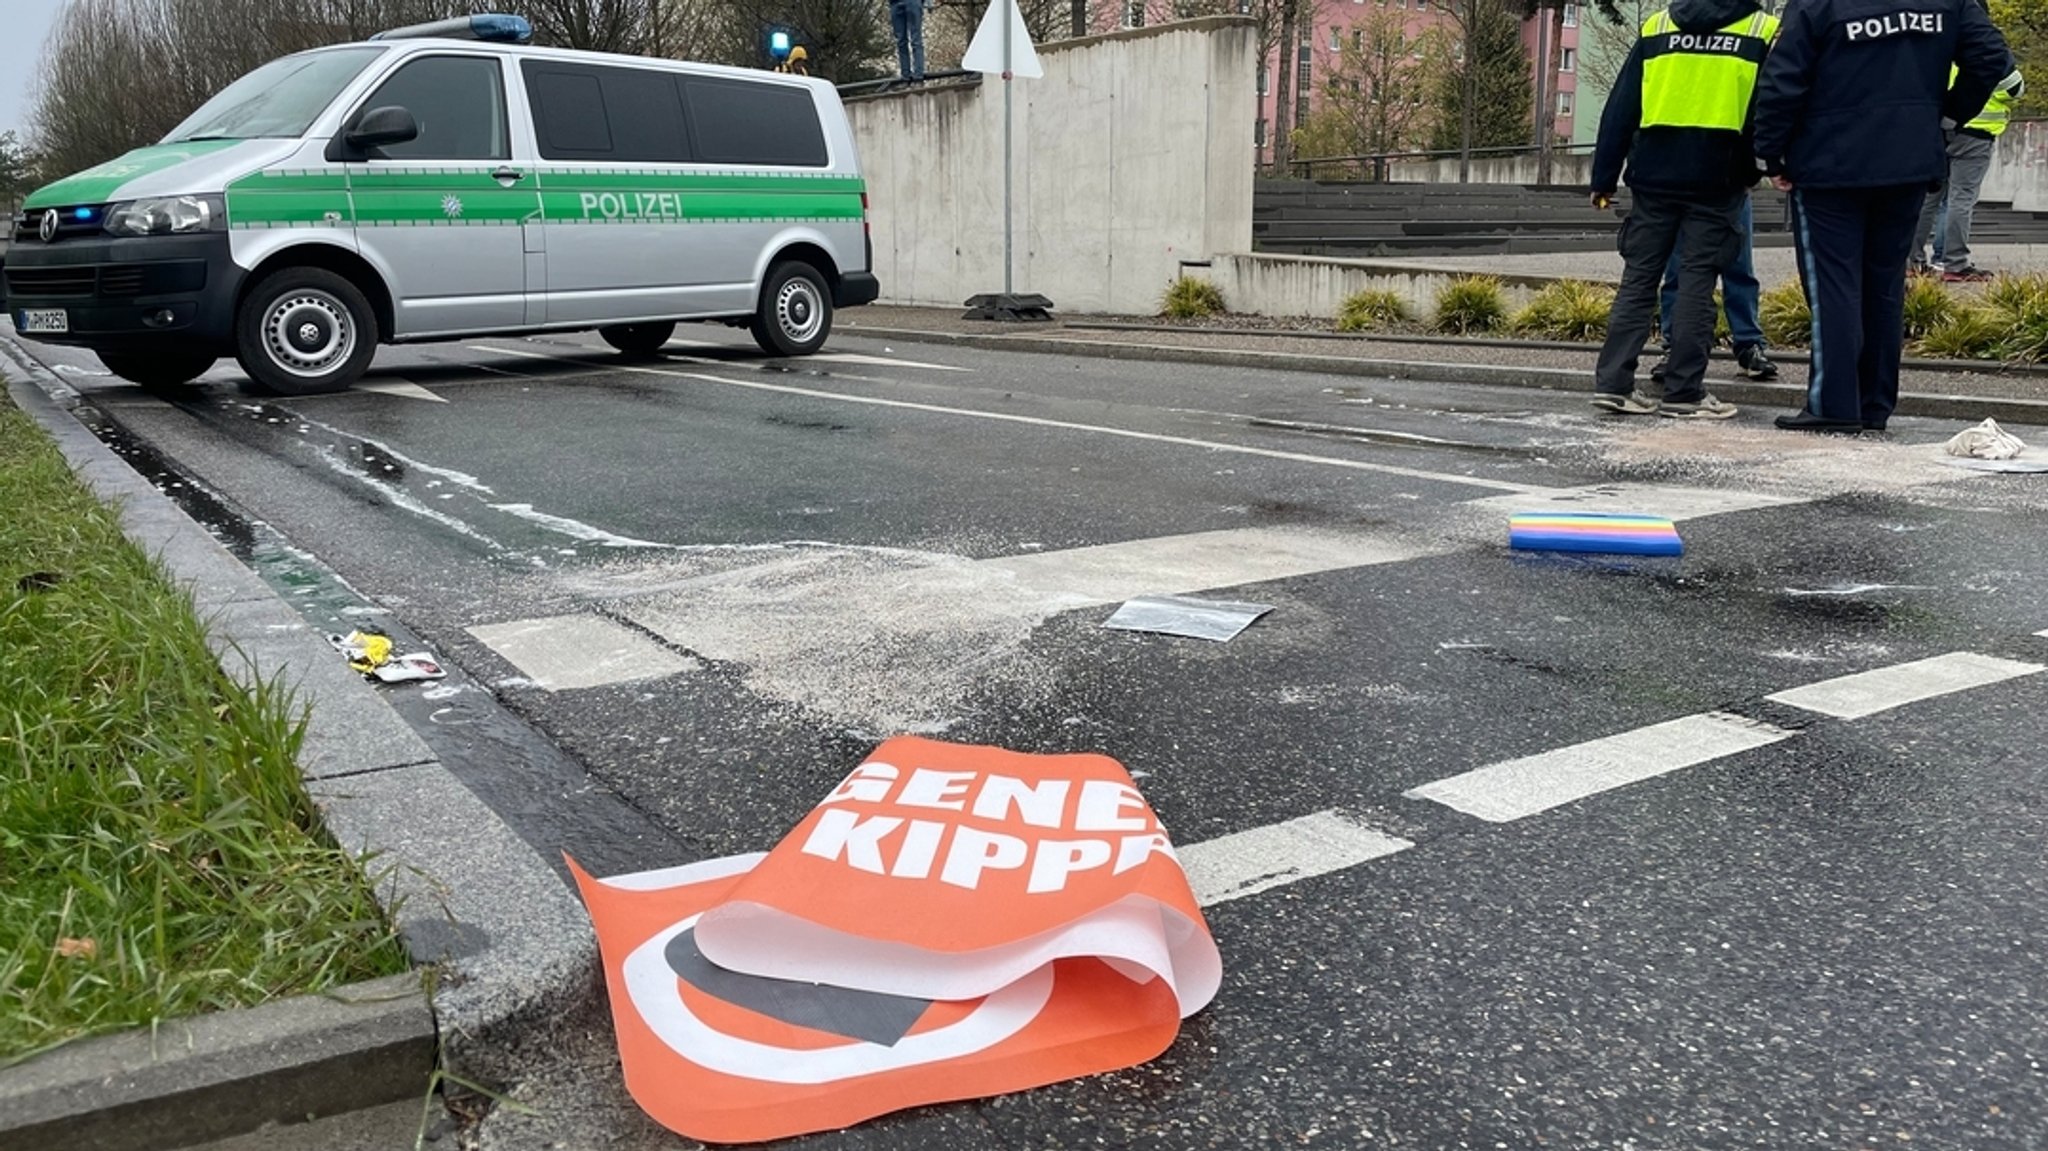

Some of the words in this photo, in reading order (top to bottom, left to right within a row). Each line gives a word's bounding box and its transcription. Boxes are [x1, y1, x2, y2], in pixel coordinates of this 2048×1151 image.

[1846, 11, 1943, 40] POLIZEI
[1668, 34, 1741, 52] POLIZEI
[580, 191, 683, 219] POLIZEI
[817, 761, 1169, 832] GENE
